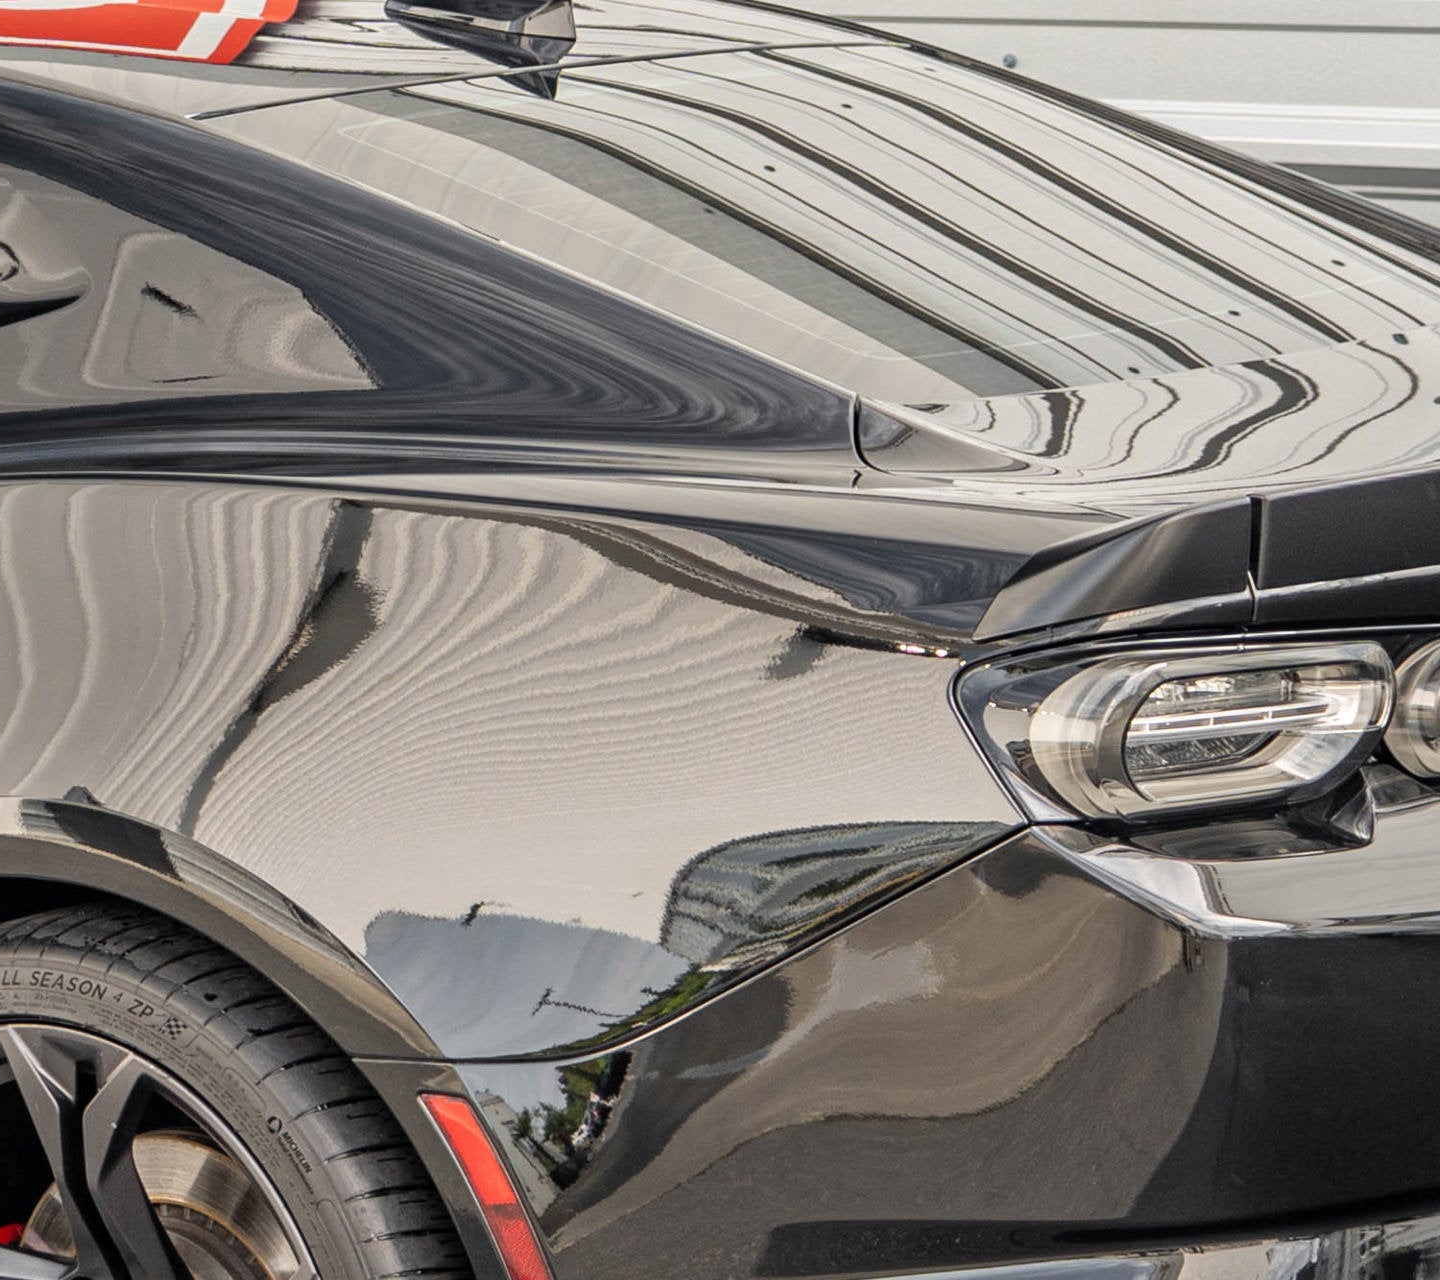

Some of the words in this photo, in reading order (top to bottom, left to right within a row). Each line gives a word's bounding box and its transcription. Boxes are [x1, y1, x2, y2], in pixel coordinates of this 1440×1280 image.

[28, 970, 108, 1001] SEASON
[126, 998, 155, 1019] ZP
[281, 1130, 312, 1173] MICHELIN
